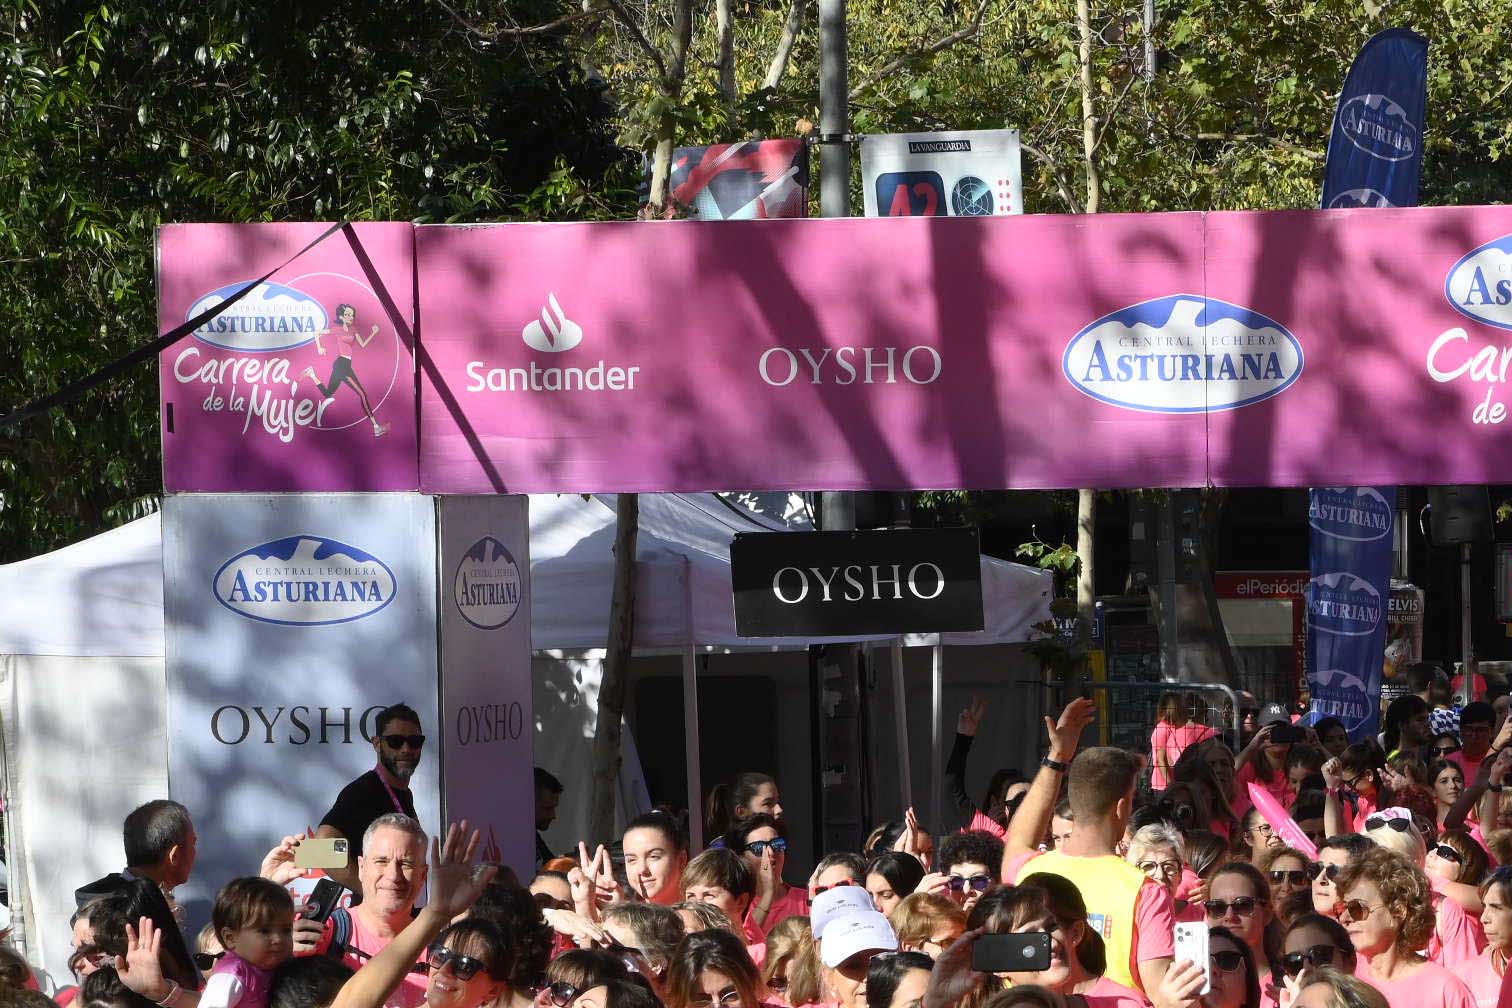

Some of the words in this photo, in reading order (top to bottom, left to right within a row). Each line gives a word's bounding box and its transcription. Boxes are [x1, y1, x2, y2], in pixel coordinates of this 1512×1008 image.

[1119, 336, 1193, 348] CENTRAL
[1202, 334, 1277, 347] LECHERA
[174, 346, 291, 385] Carrera
[466, 359, 640, 392] Santander
[758, 345, 942, 386] OYSHO
[1082, 339, 1286, 383] ASTURIANA
[203, 386, 225, 412] de
[229, 386, 245, 412] la
[242, 377, 335, 443] Mujer
[1472, 385, 1507, 425] de
[230, 569, 384, 603] ASTURIANA
[256, 567, 313, 576] CENTRAL
[319, 566, 377, 576] LECHERA
[460, 571, 518, 608] ASTURIANA
[773, 562, 946, 604] OYSHO
[1237, 578, 1311, 596] elPeriódi
[1388, 598, 1418, 612] ELVIS
[211, 704, 393, 745] OYSHO
[457, 701, 523, 747] OYSHO
